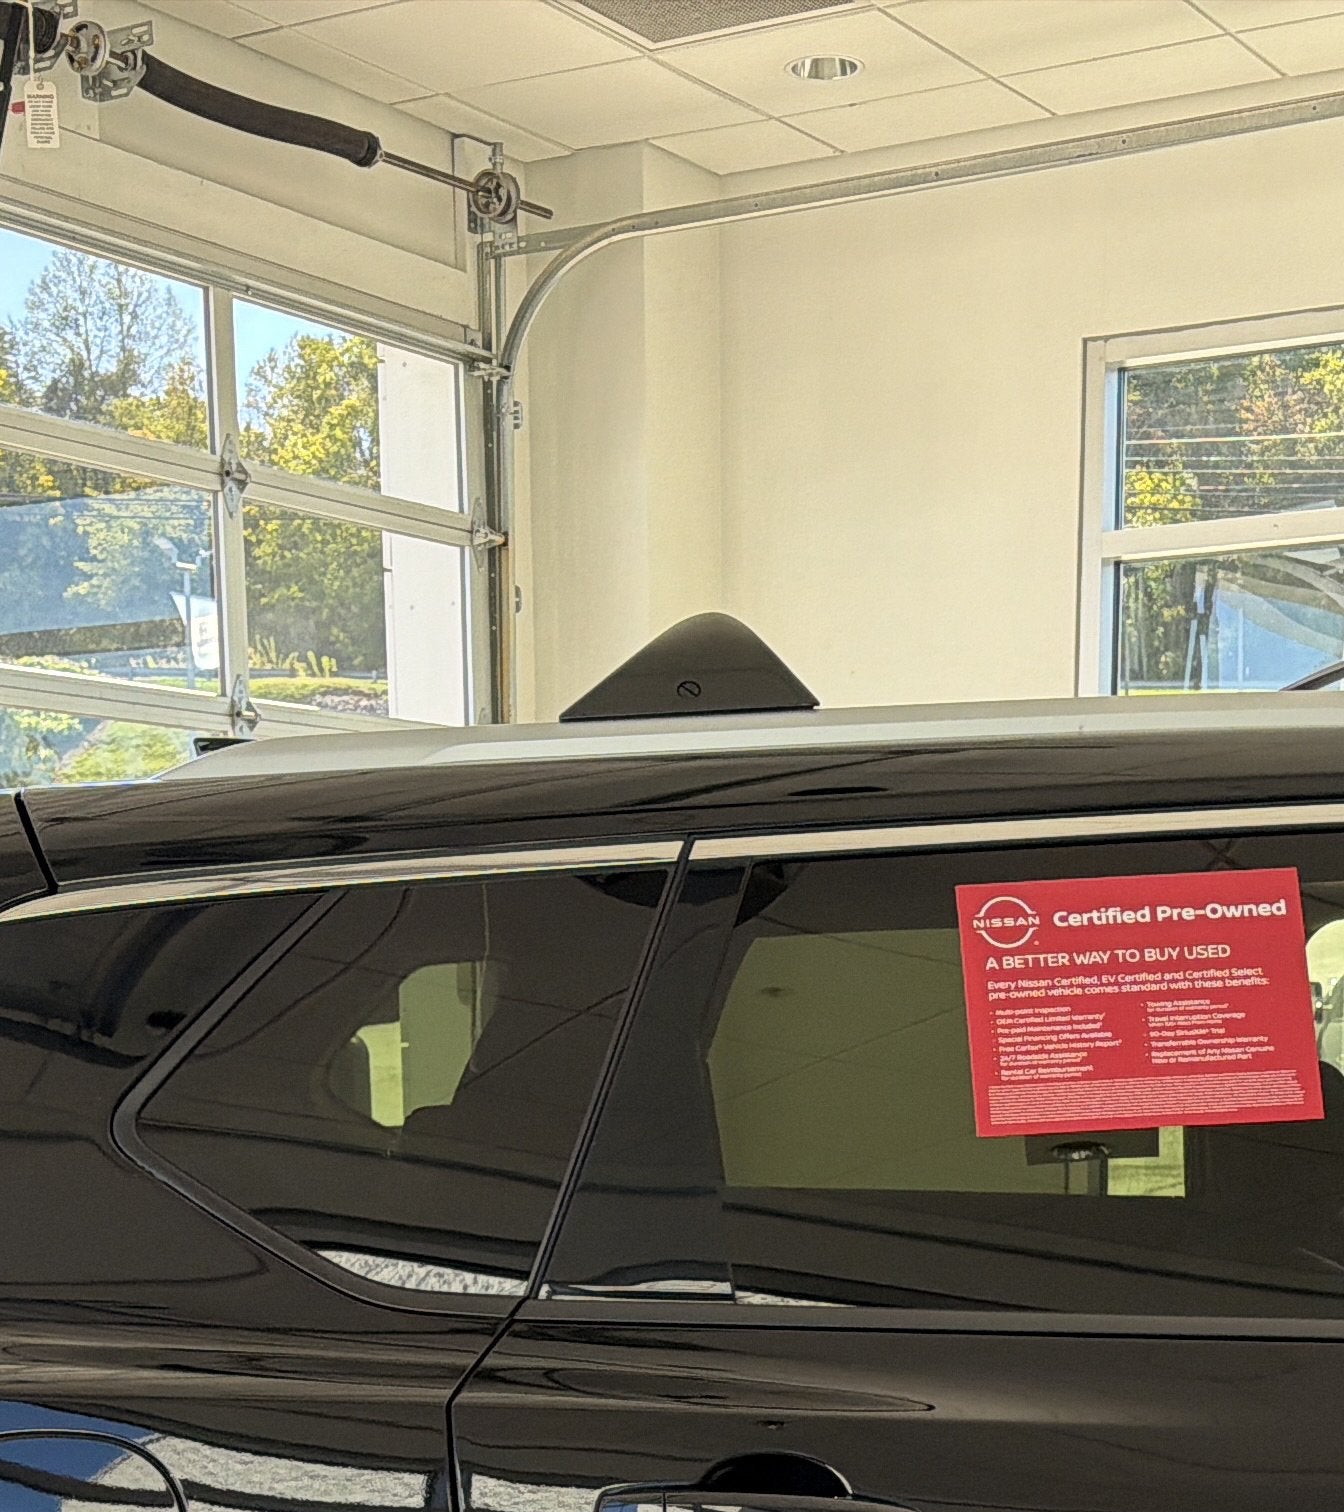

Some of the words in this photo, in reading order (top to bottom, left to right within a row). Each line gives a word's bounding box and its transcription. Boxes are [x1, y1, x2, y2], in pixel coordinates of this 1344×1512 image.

[972, 915, 1040, 929] NISSAN
[1053, 905, 1151, 927] Certified
[1156, 898, 1287, 922] Pre-Owned
[985, 956, 999, 971] A
[1002, 953, 1070, 969] BETTER
[1073, 950, 1111, 966] WAY
[1114, 949, 1140, 963] TO
[1144, 946, 1181, 962] BUY
[1184, 944, 1231, 960] USED
[987, 980, 1016, 990] Every
[1018, 977, 1052, 988] Nissan
[1054, 975, 1100, 987] Certified,
[1102, 974, 1116, 983] EV
[1117, 971, 1162, 983] Certified
[1164, 970, 1184, 981] and
[1185, 968, 1230, 979] Certified
[1231, 966, 1264, 977] Select
[988, 988, 1046, 1001] pre-owned
[1047, 985, 1083, 996] vehicle
[1084, 984, 1119, 994] comes
[1121, 981, 1168, 993] standard
[1169, 979, 1193, 990] with
[1194, 978, 1225, 988] these
[1225, 976, 1270, 987] benefits:
